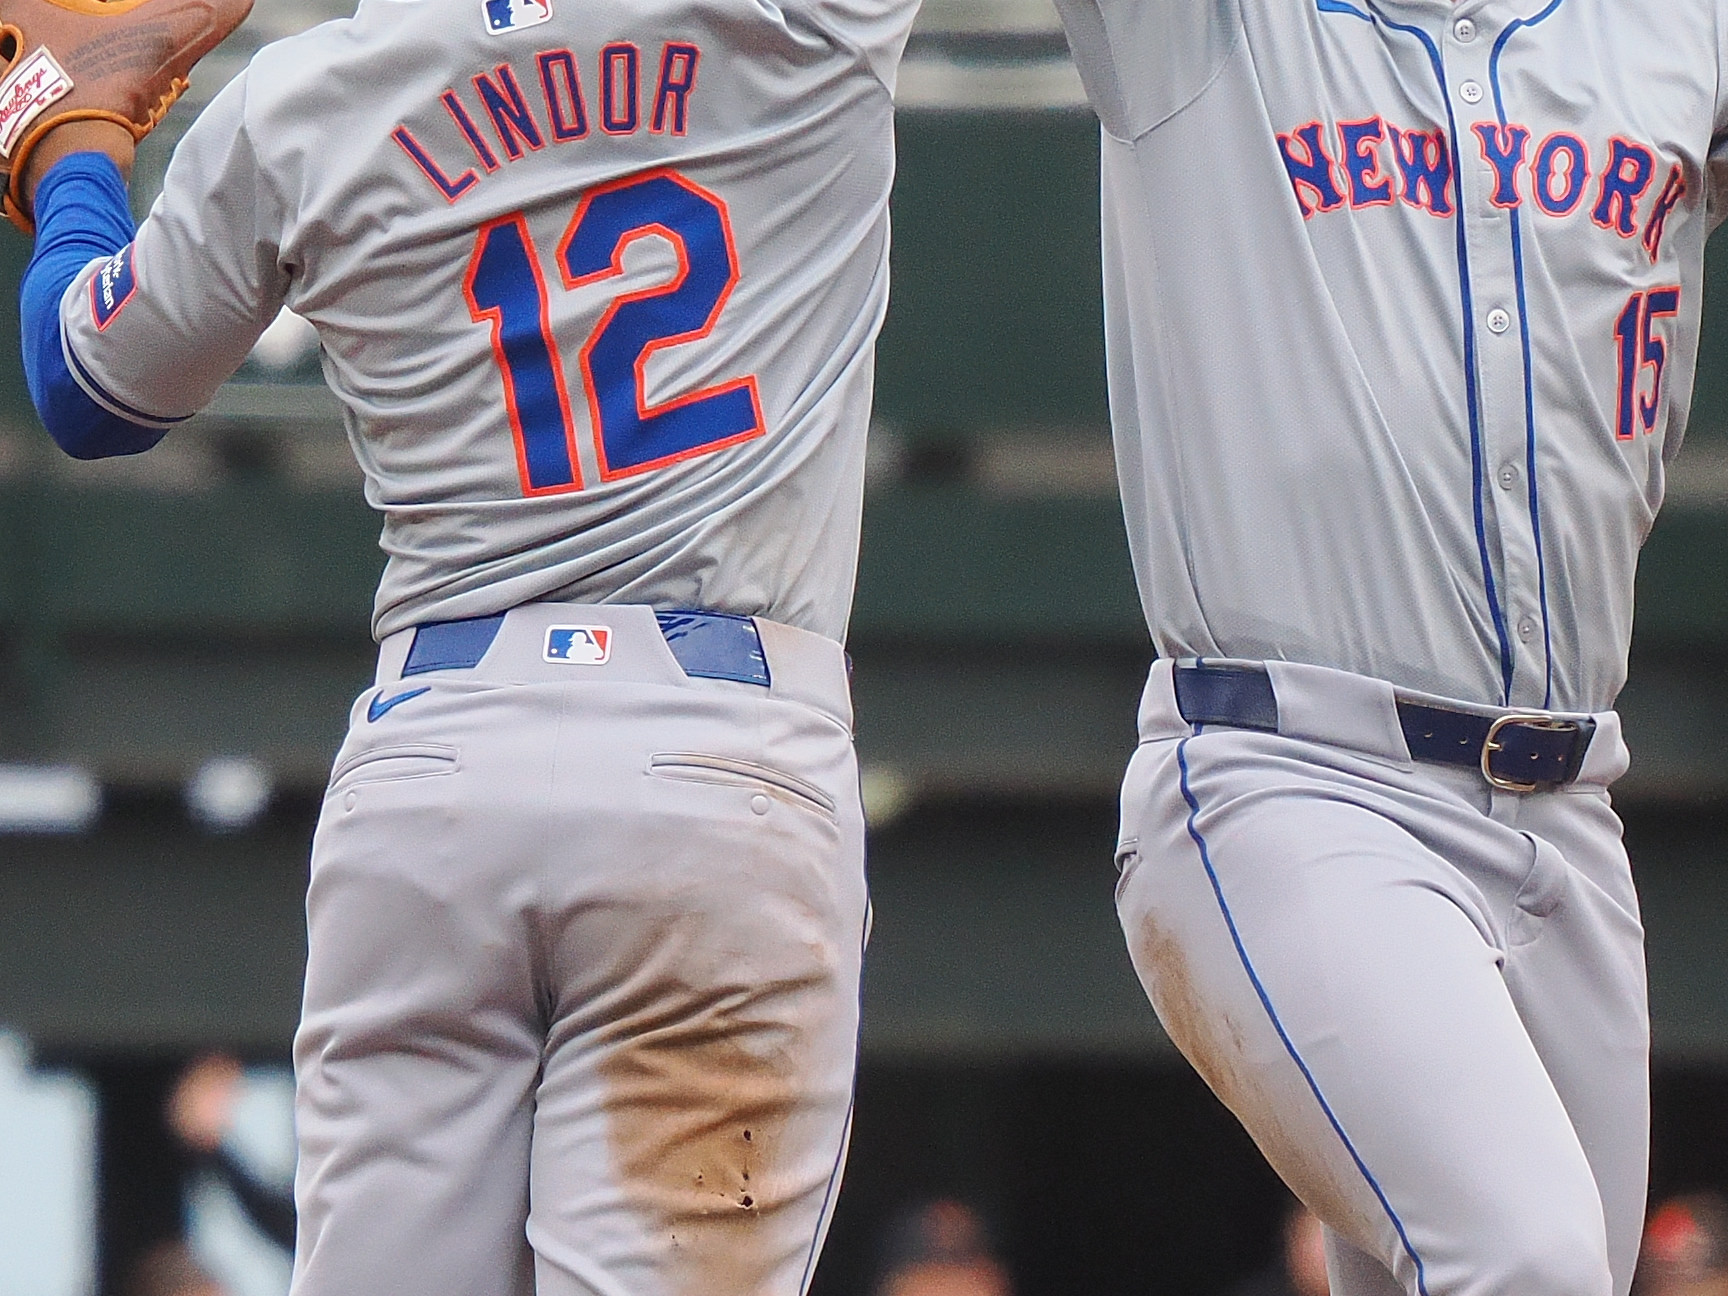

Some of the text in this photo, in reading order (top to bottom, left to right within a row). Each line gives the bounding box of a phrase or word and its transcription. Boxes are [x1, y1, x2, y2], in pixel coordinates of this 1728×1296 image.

[391, 41, 700, 204] LINDOR
[1275, 115, 1456, 220] NEW
[462, 167, 766, 498] 12
[1613, 285, 1682, 441] 15
